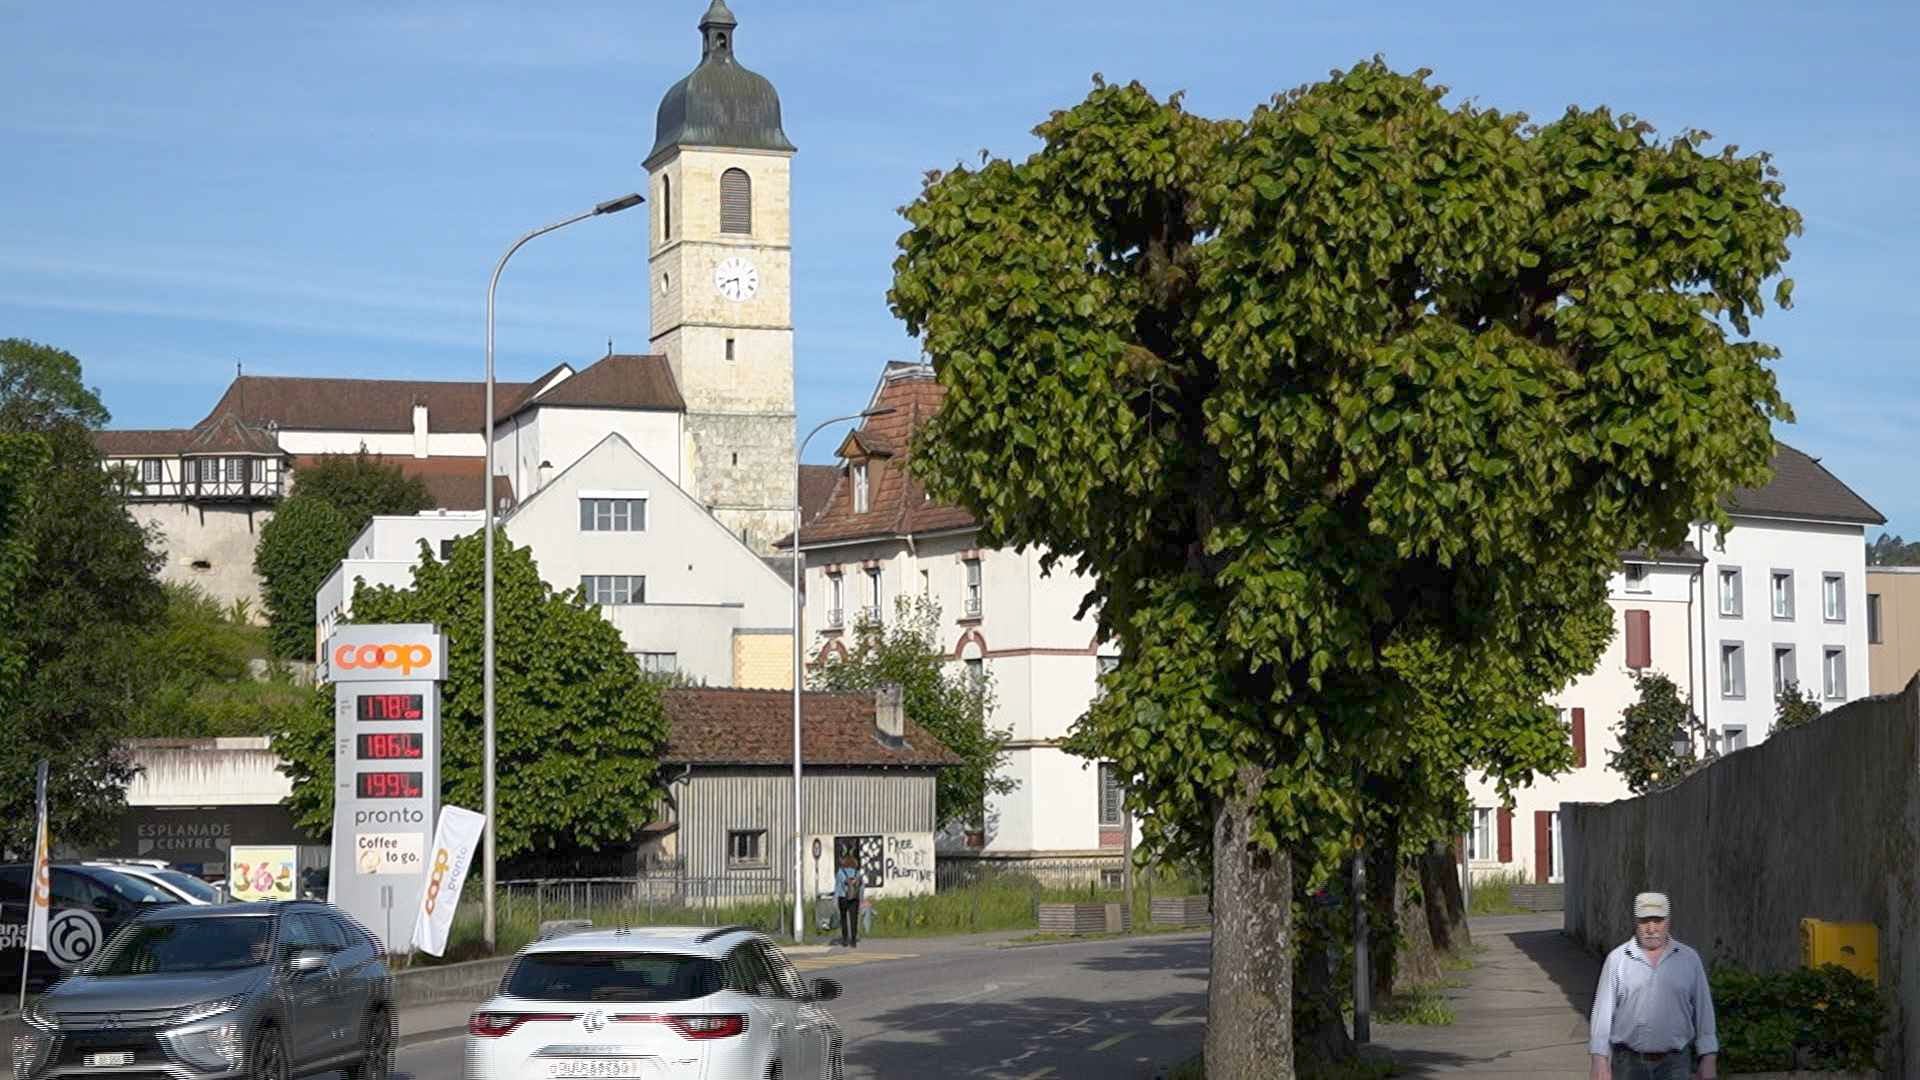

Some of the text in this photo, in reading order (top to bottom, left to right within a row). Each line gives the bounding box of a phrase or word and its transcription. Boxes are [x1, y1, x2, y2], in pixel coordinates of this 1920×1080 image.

[335, 644, 432, 675] coop
[355, 807, 423, 826] pronto
[138, 824, 232, 836] ESPLANADE
[156, 838, 213, 849] CENTRE
[358, 837, 398, 849] Coffee
[386, 851, 398, 862] to
